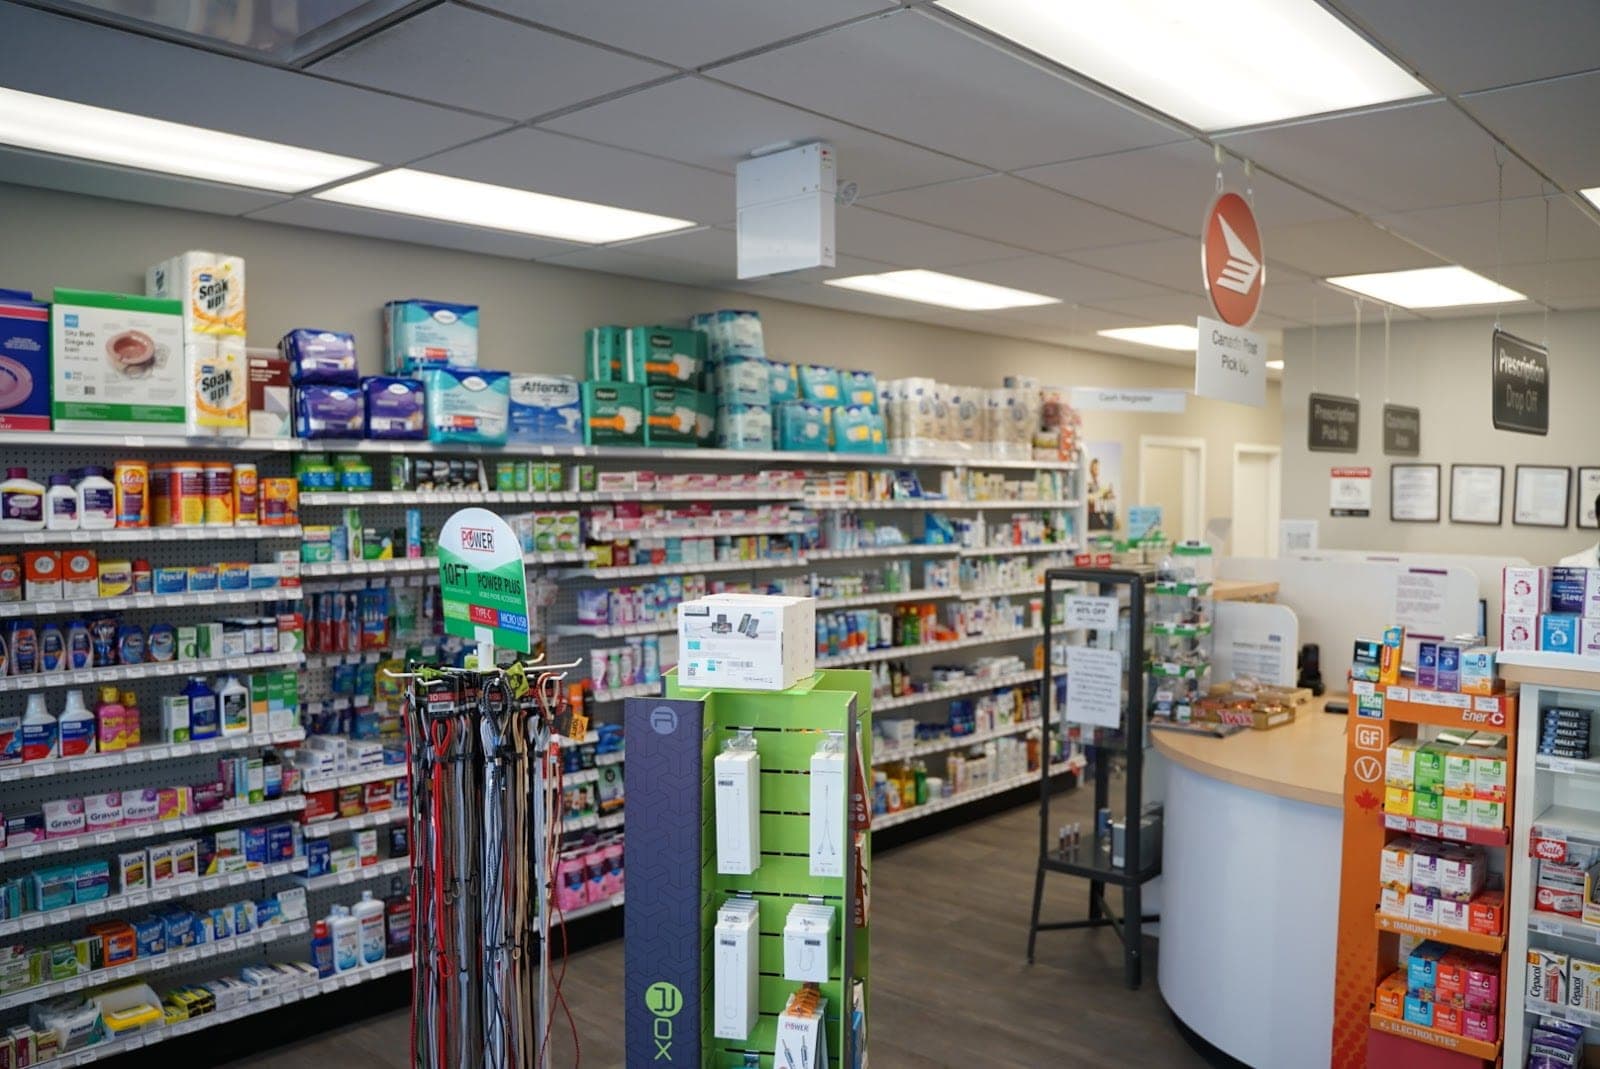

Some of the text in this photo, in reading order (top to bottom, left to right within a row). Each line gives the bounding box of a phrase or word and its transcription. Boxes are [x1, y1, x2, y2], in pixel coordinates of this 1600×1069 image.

[199, 279, 229, 300] Soak
[207, 293, 226, 310] up!
[1499, 347, 1545, 385] Prescription
[202, 370, 232, 392] Soak
[210, 384, 230, 401] up!
[443, 562, 469, 587] 10FT
[477, 573, 502, 593] POWER
[504, 577, 521, 595] PLUS
[1217, 709, 1254, 727] Twix
[1359, 730, 1380, 746] GF
[90, 810, 121, 821] Gravol
[127, 805, 156, 816] Gravol
[51, 817, 82, 829] Gravol
[1542, 843, 1561, 855] Sale
